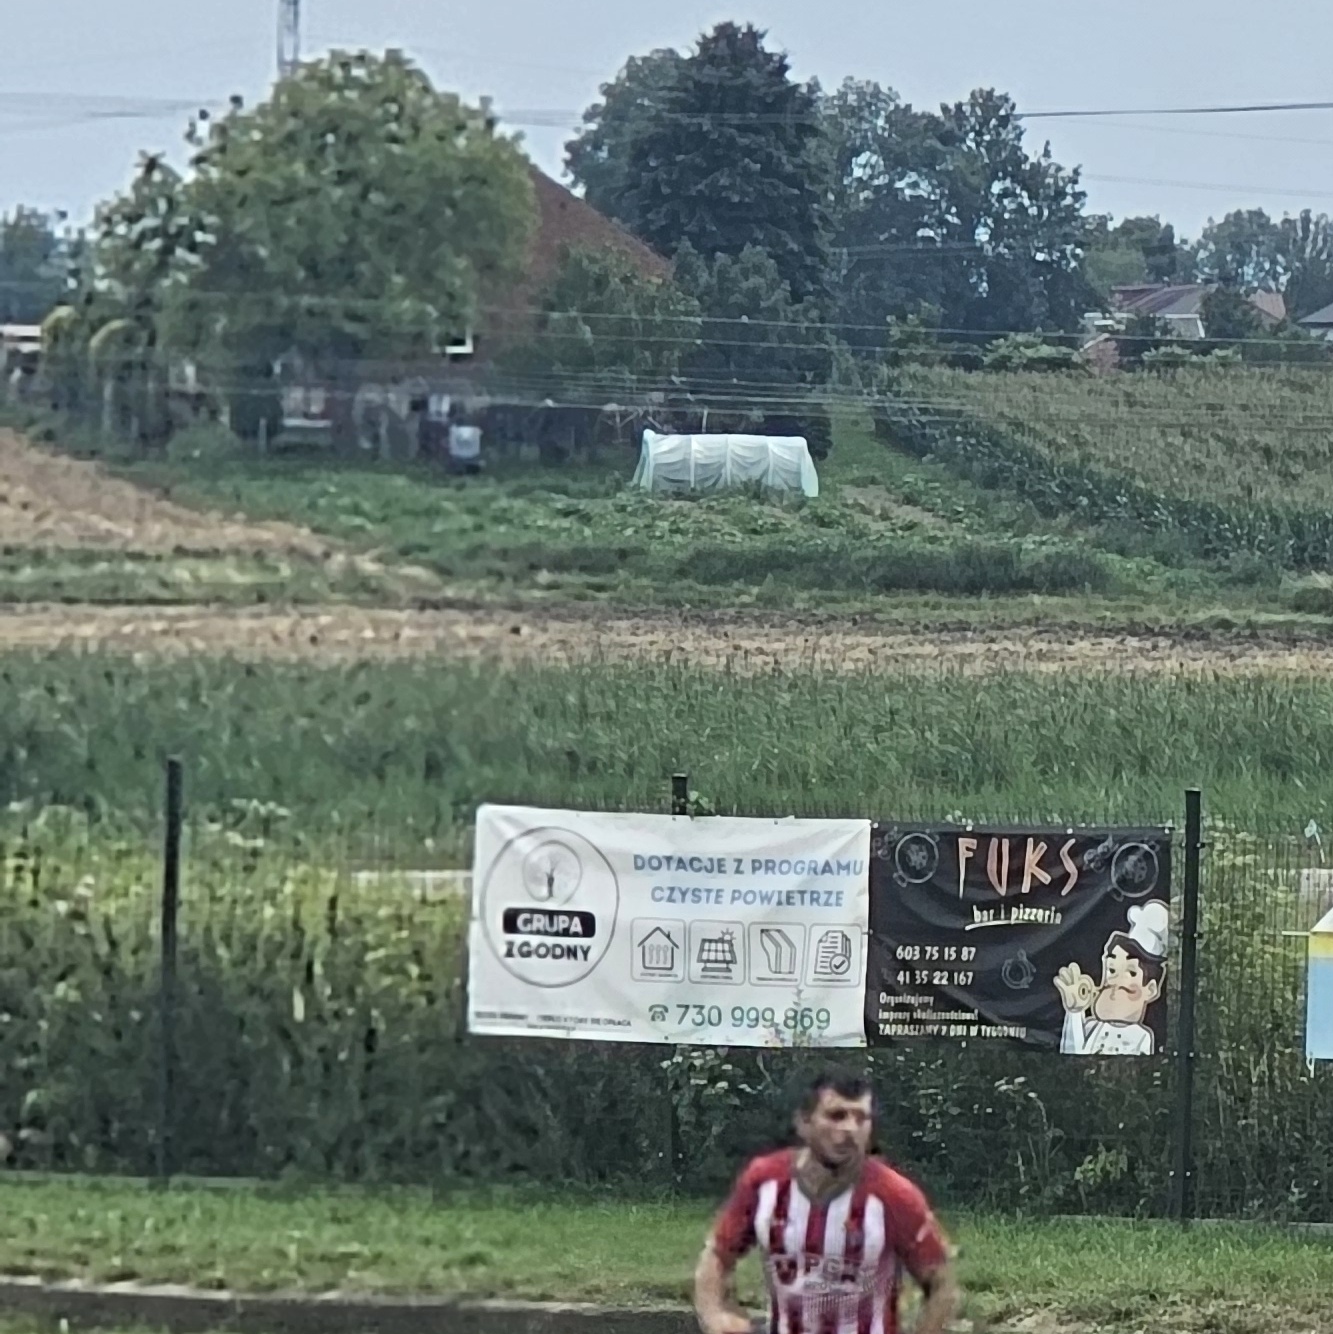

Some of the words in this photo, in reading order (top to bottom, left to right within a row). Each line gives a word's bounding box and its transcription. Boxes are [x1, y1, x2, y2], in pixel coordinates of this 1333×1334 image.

[633, 853, 727, 875] DOTACJE
[734, 857, 744, 875] Z
[751, 858, 864, 877] PROGRAMU
[958, 837, 1078, 899] FUKS
[651, 886, 723, 905] CZYSTE
[730, 889, 844, 907] POWIETRZE
[516, 913, 584, 936] GRUPA
[973, 905, 994, 923] bar
[1011, 903, 1062, 924] pizzeria
[504, 941, 591, 963] ZGODNY
[896, 945, 920, 960] 603
[925, 946, 939, 960] 75
[944, 946, 957, 960] 15
[961, 947, 976, 961] 87
[897, 971, 910, 985] 41
[915, 971, 929, 985] 35
[932, 971, 949, 985] 22
[953, 971, 974, 985] 167
[676, 1004, 722, 1027] 730
[731, 1006, 775, 1029] 999
[783, 1008, 831, 1030] 869
